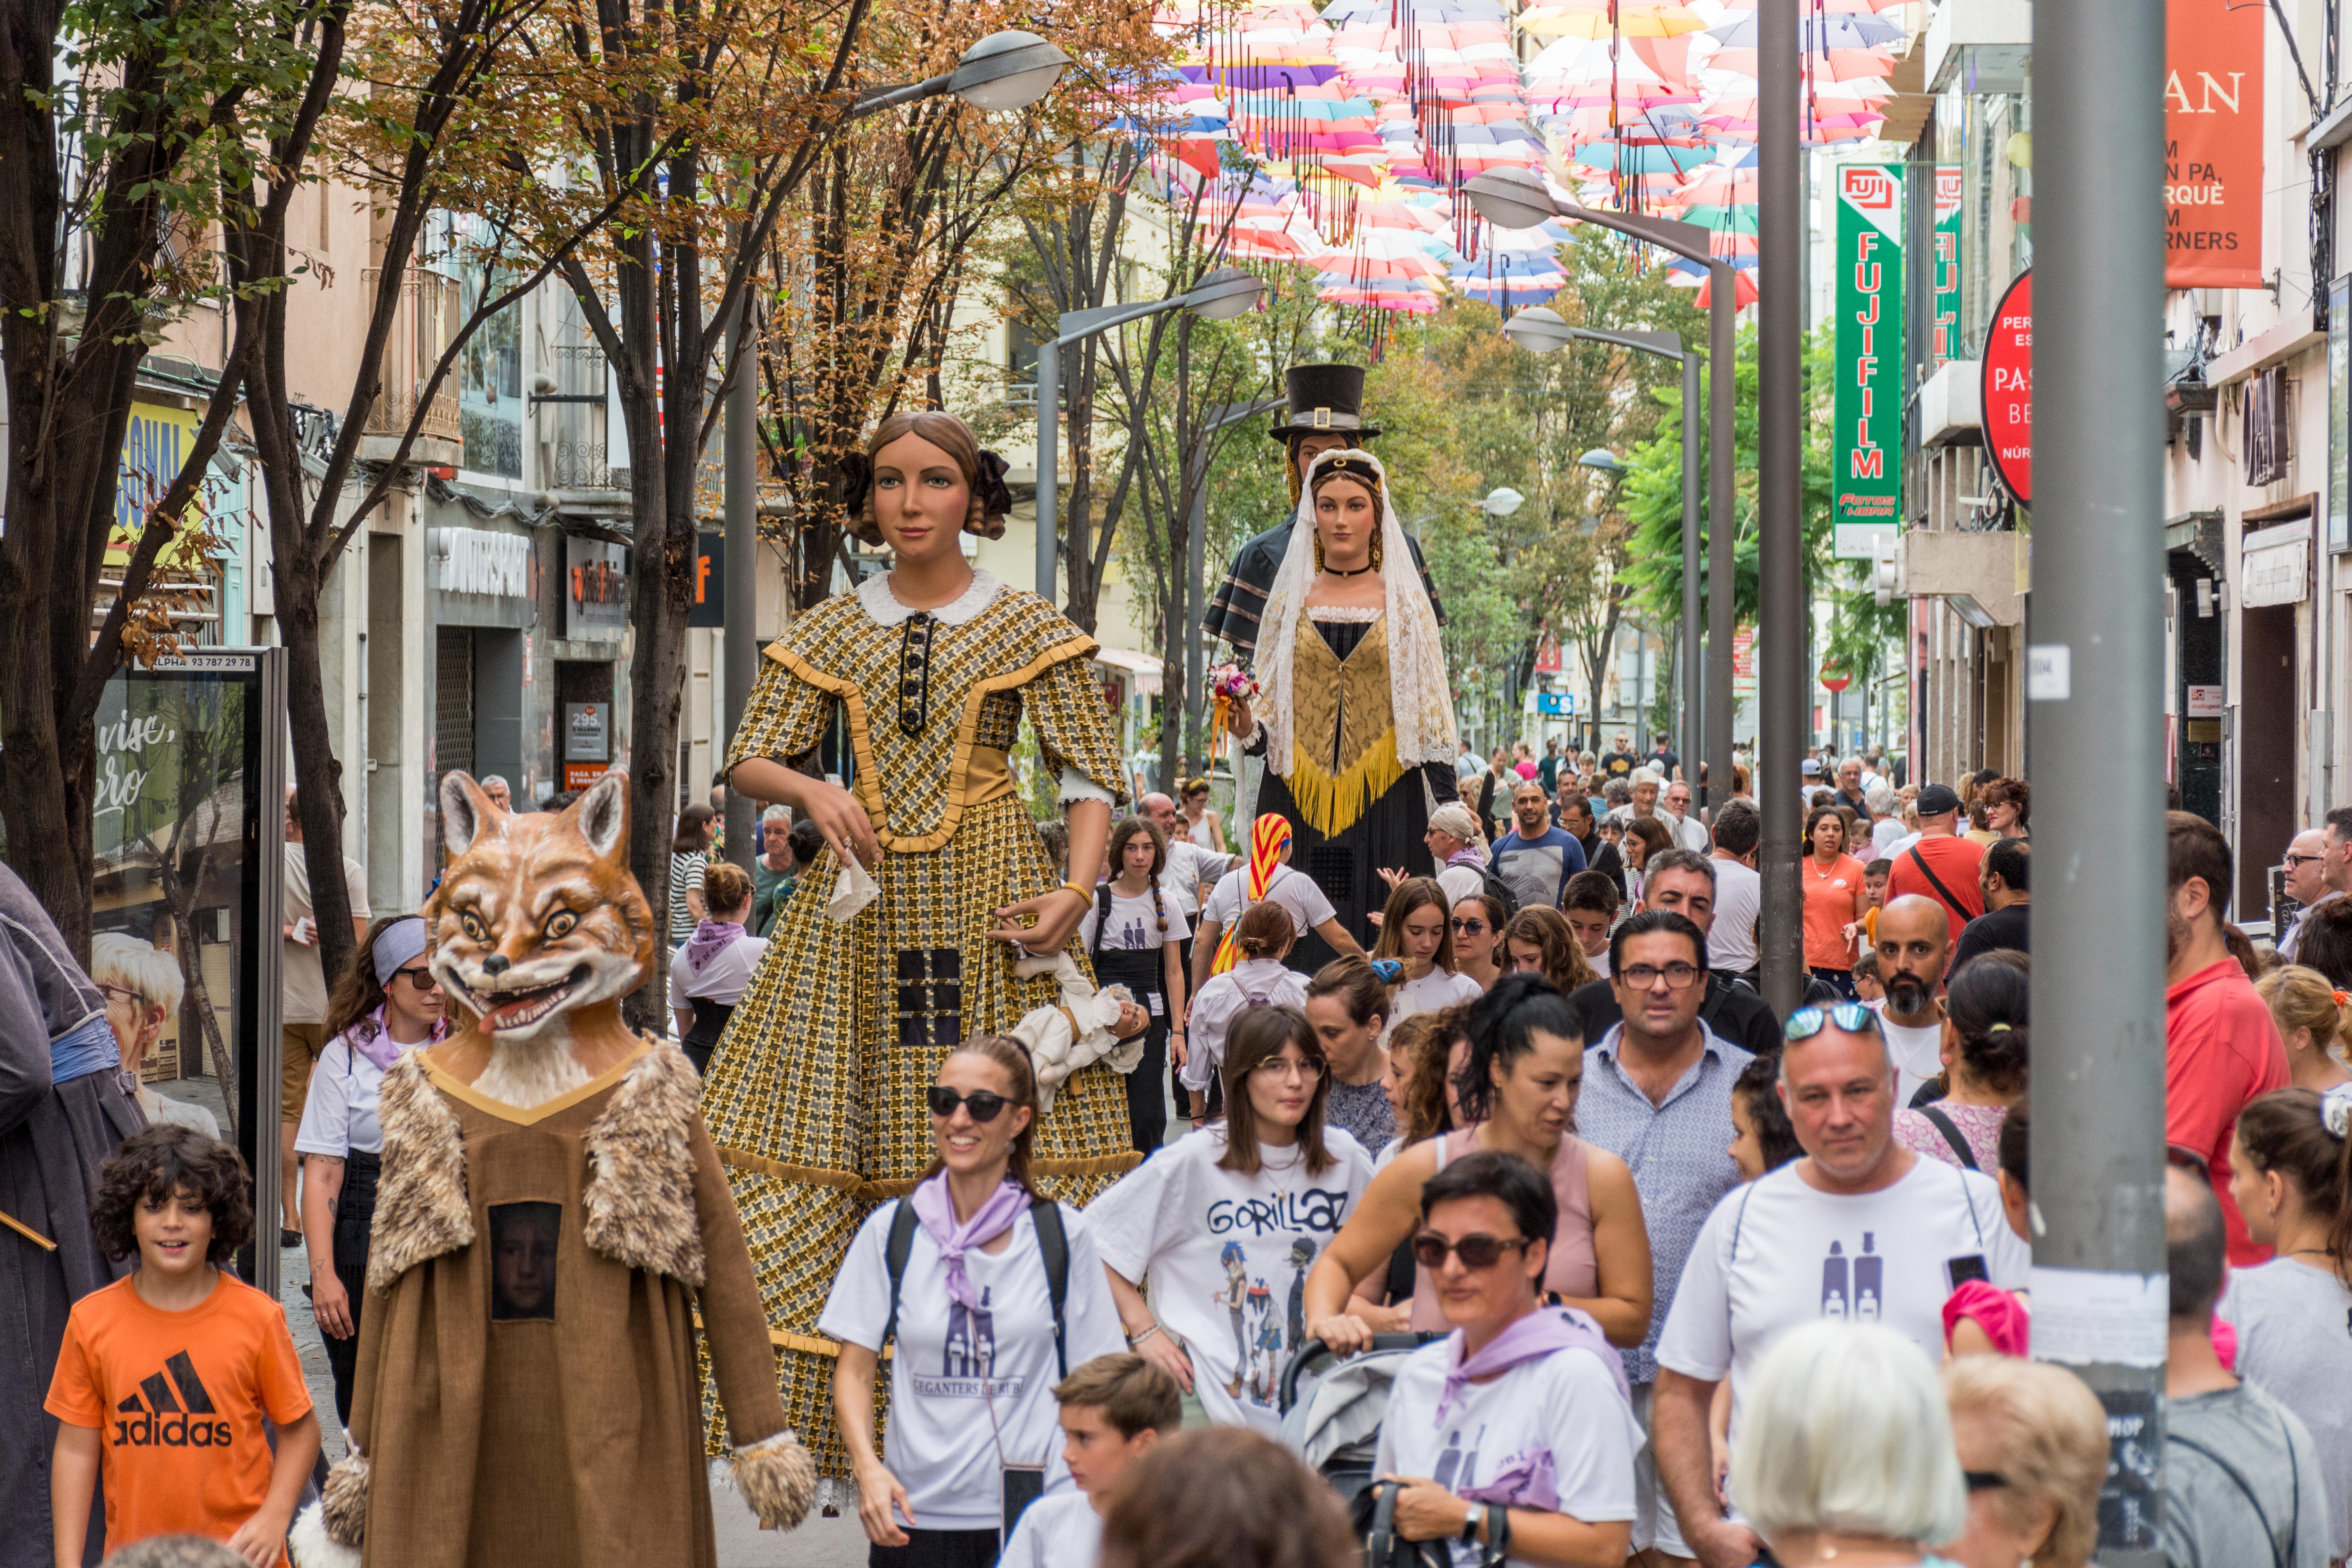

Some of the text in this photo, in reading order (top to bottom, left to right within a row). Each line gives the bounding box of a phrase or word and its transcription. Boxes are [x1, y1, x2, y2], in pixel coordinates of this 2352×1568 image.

[2189, 163, 2222, 184] PA,
[1846, 169, 1892, 209] FUJI
[1851, 231, 1883, 479] FUJIFILM
[1840, 505, 1894, 516] 1 HORA
[703, 951, 710, 960] DE
[711, 938, 727, 953] RUBI
[913, 1379, 979, 1395] GEGANTERS
[114, 1412, 232, 1448] adidas
